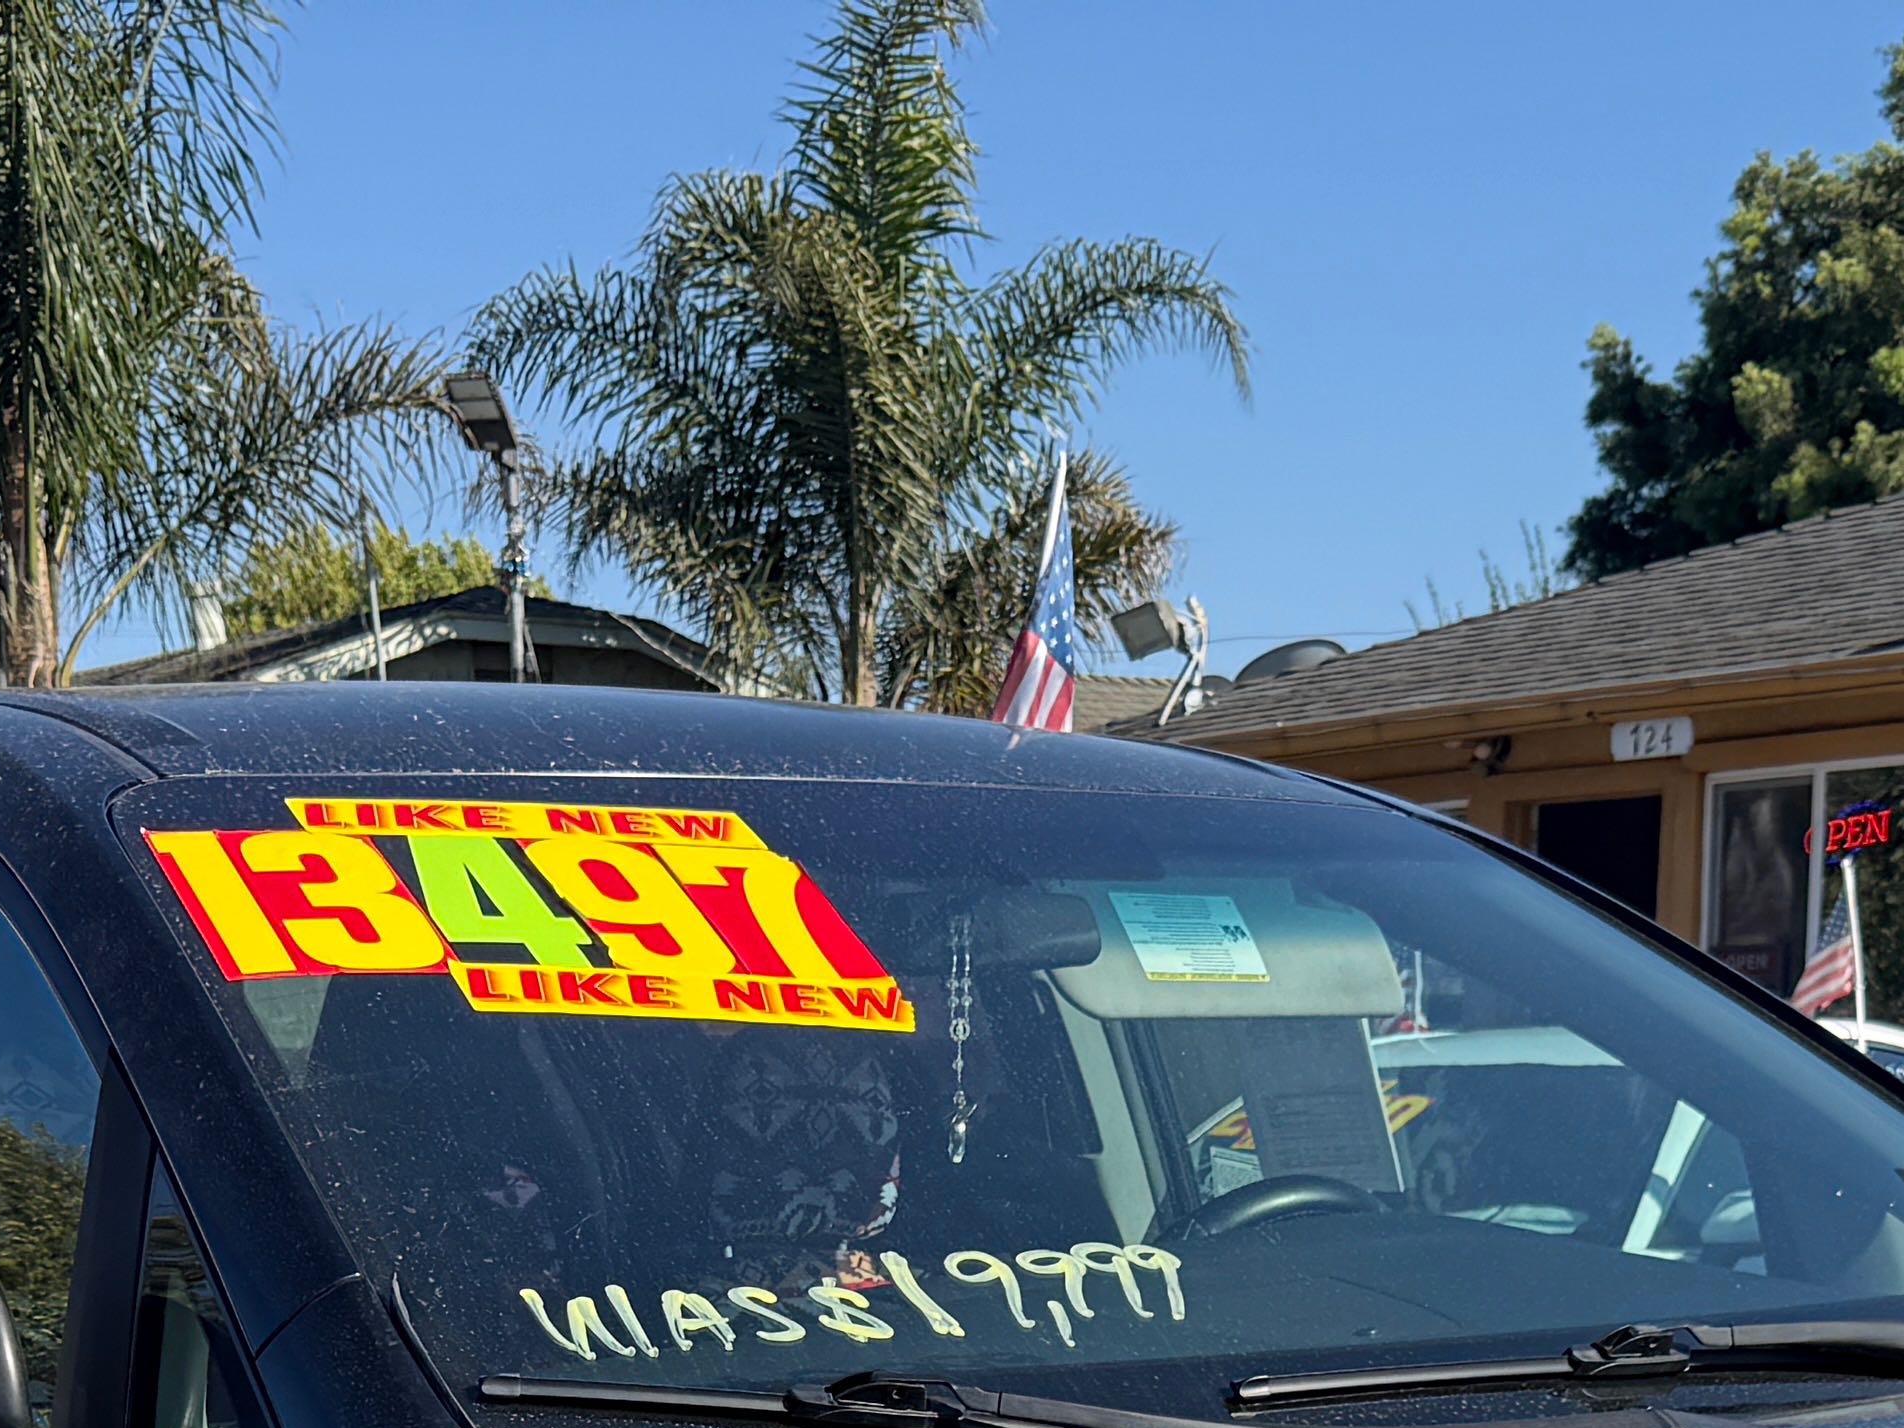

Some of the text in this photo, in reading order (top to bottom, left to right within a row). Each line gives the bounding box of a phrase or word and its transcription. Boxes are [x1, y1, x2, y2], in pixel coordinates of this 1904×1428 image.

[304, 803, 727, 841] LIKE NEW
[148, 831, 844, 978] 13497
[466, 968, 901, 1020] LIKE NEW
